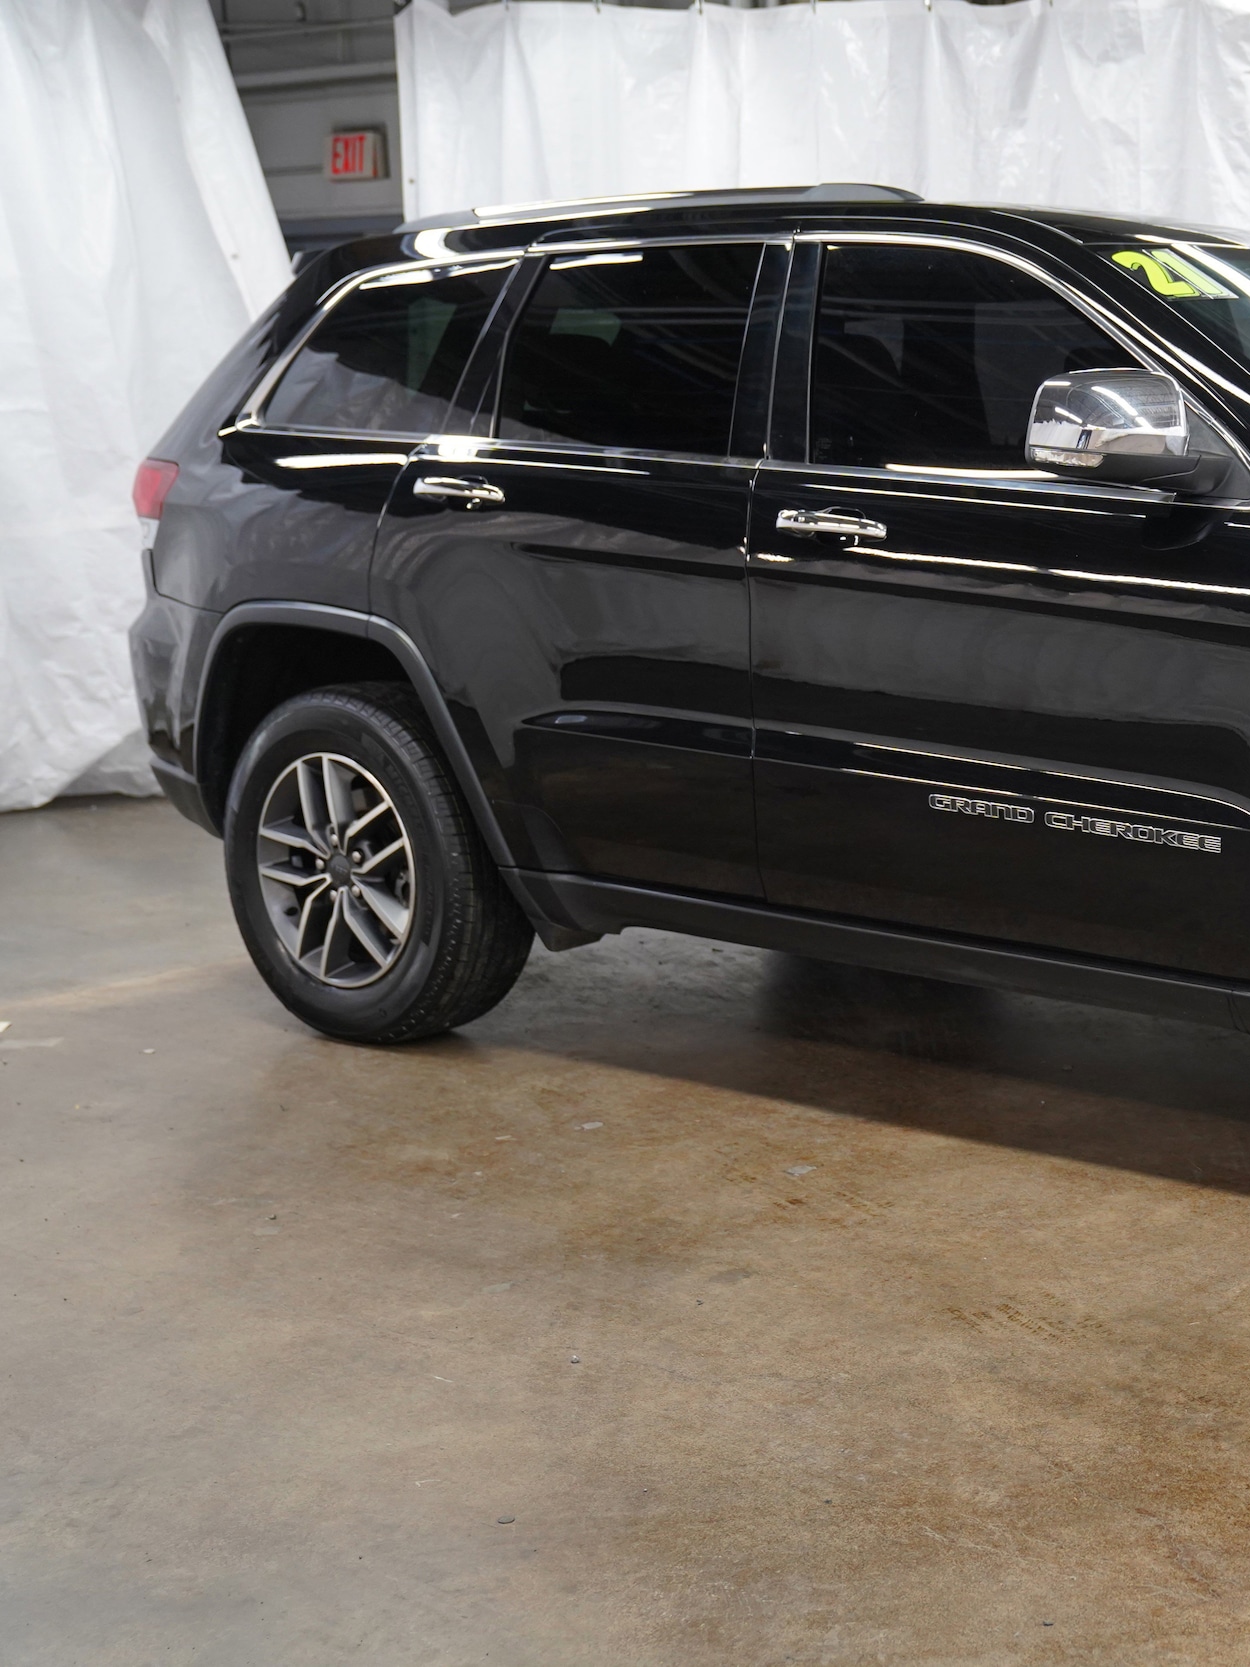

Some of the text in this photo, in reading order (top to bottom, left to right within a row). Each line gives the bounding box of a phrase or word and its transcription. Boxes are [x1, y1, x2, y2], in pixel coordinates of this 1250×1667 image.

[331, 134, 365, 175] EXIT
[1111, 250, 1226, 298] 21
[928, 793, 1222, 853] GRAND CHEROKEE
